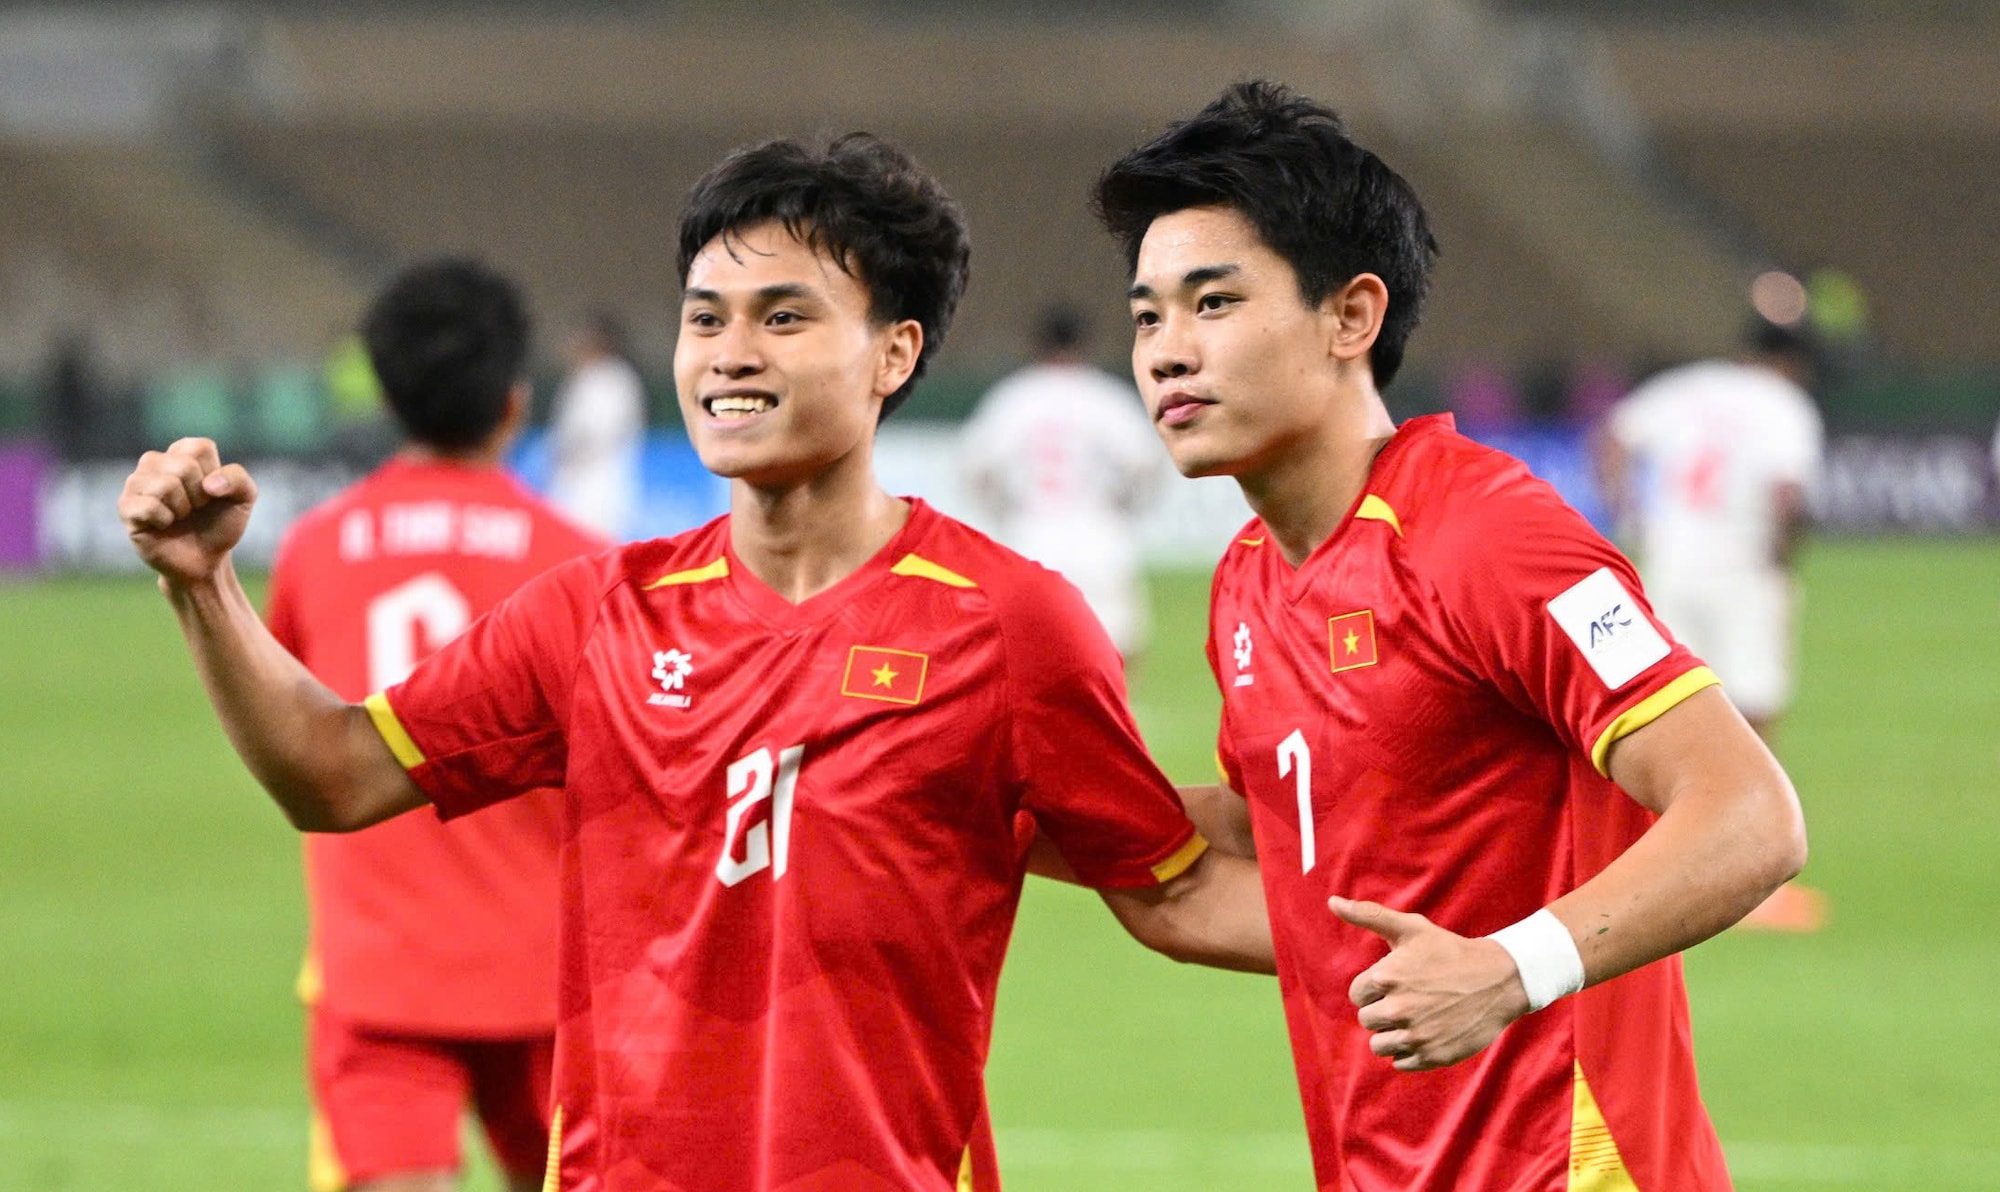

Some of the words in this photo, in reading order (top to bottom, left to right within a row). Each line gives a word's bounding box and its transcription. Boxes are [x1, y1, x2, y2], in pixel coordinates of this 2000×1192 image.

[1590, 603, 1632, 649] AFC
[715, 743, 805, 888] 21
[1276, 728, 1316, 876] 7
